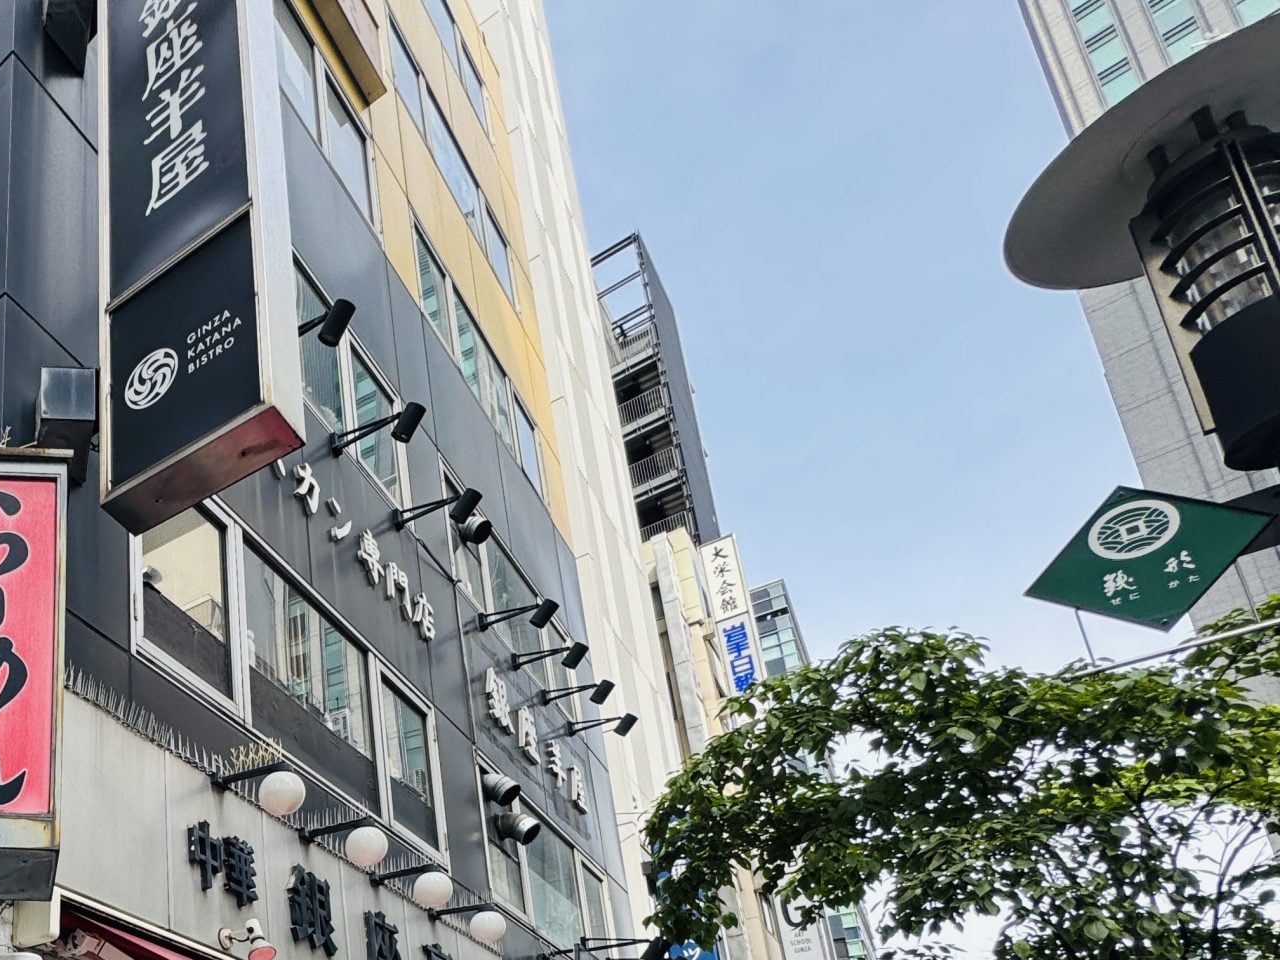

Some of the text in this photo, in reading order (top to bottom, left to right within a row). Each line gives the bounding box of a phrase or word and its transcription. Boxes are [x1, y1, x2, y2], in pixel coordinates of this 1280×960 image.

[186, 309, 231, 344] GINZA
[187, 317, 242, 359] KATANA
[188, 337, 235, 374] BISTRO
[274, 458, 437, 642] カン専門店
